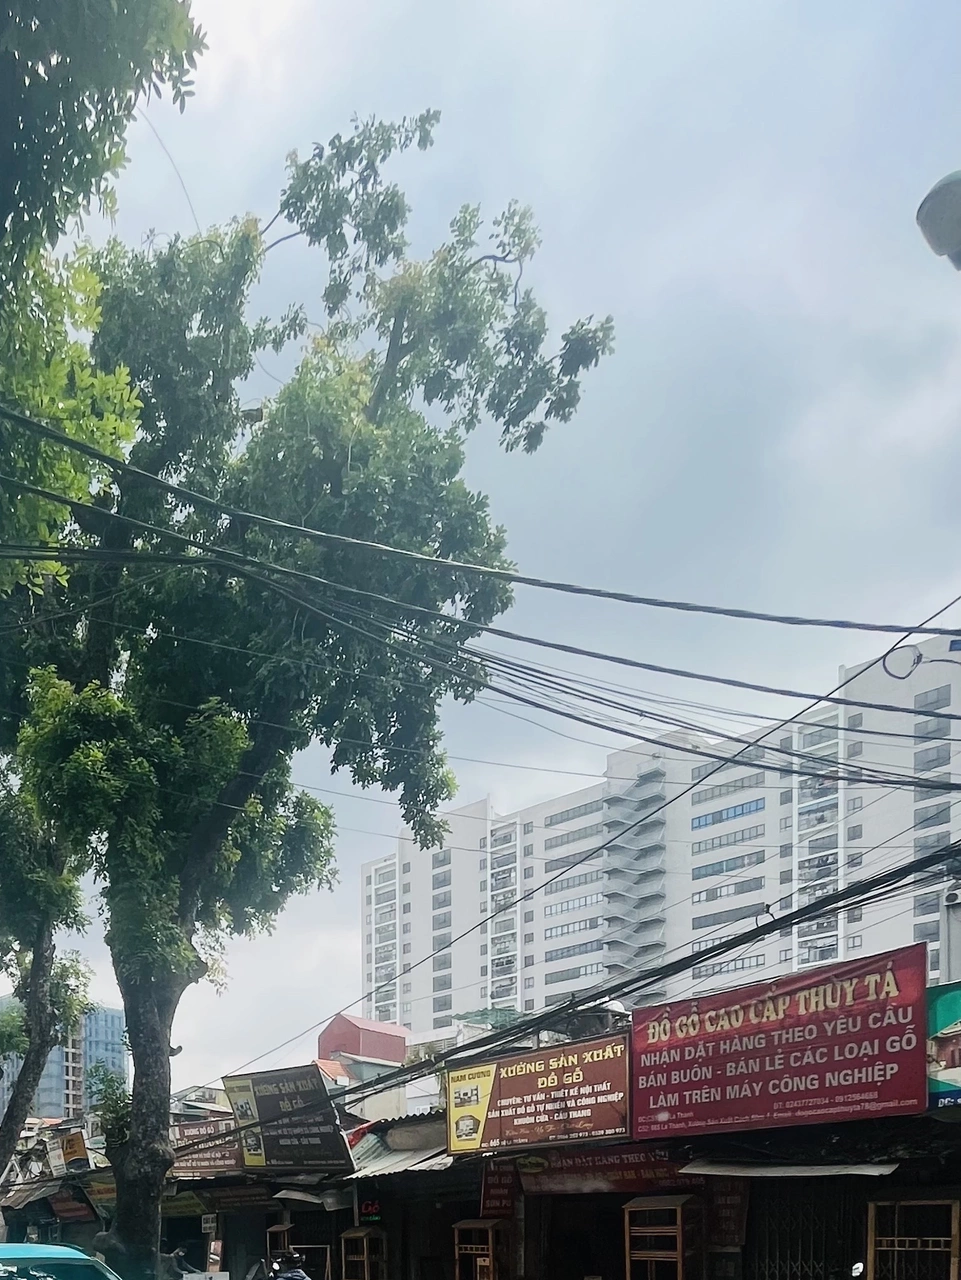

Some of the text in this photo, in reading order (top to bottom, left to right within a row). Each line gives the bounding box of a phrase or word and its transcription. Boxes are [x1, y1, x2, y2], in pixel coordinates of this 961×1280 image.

[640, 1047, 681, 1069] NHẬN
[719, 1034, 767, 1054] HÀNG
[770, 1025, 818, 1046] THEO
[823, 1014, 862, 1037] YÊU
[868, 1001, 914, 1029] CẦU
[647, 1006, 671, 1044] ĐỒ
[674, 1001, 701, 1039] GỖ
[704, 1005, 745, 1033] CAO
[582, 1042, 625, 1064] XUẤT
[638, 1072, 668, 1089] BÁN
[671, 1063, 713, 1084] BUÔN
[726, 1057, 760, 1077] BÁN
[765, 1048, 785, 1071] LẺ
[789, 1045, 829, 1067] CÁC
[834, 1038, 879, 1062] LOẠI
[885, 1024, 918, 1053] GỖ
[649, 1060, 899, 1109] LÀM TRÊN MÁY CÔNG NGHIỆP
